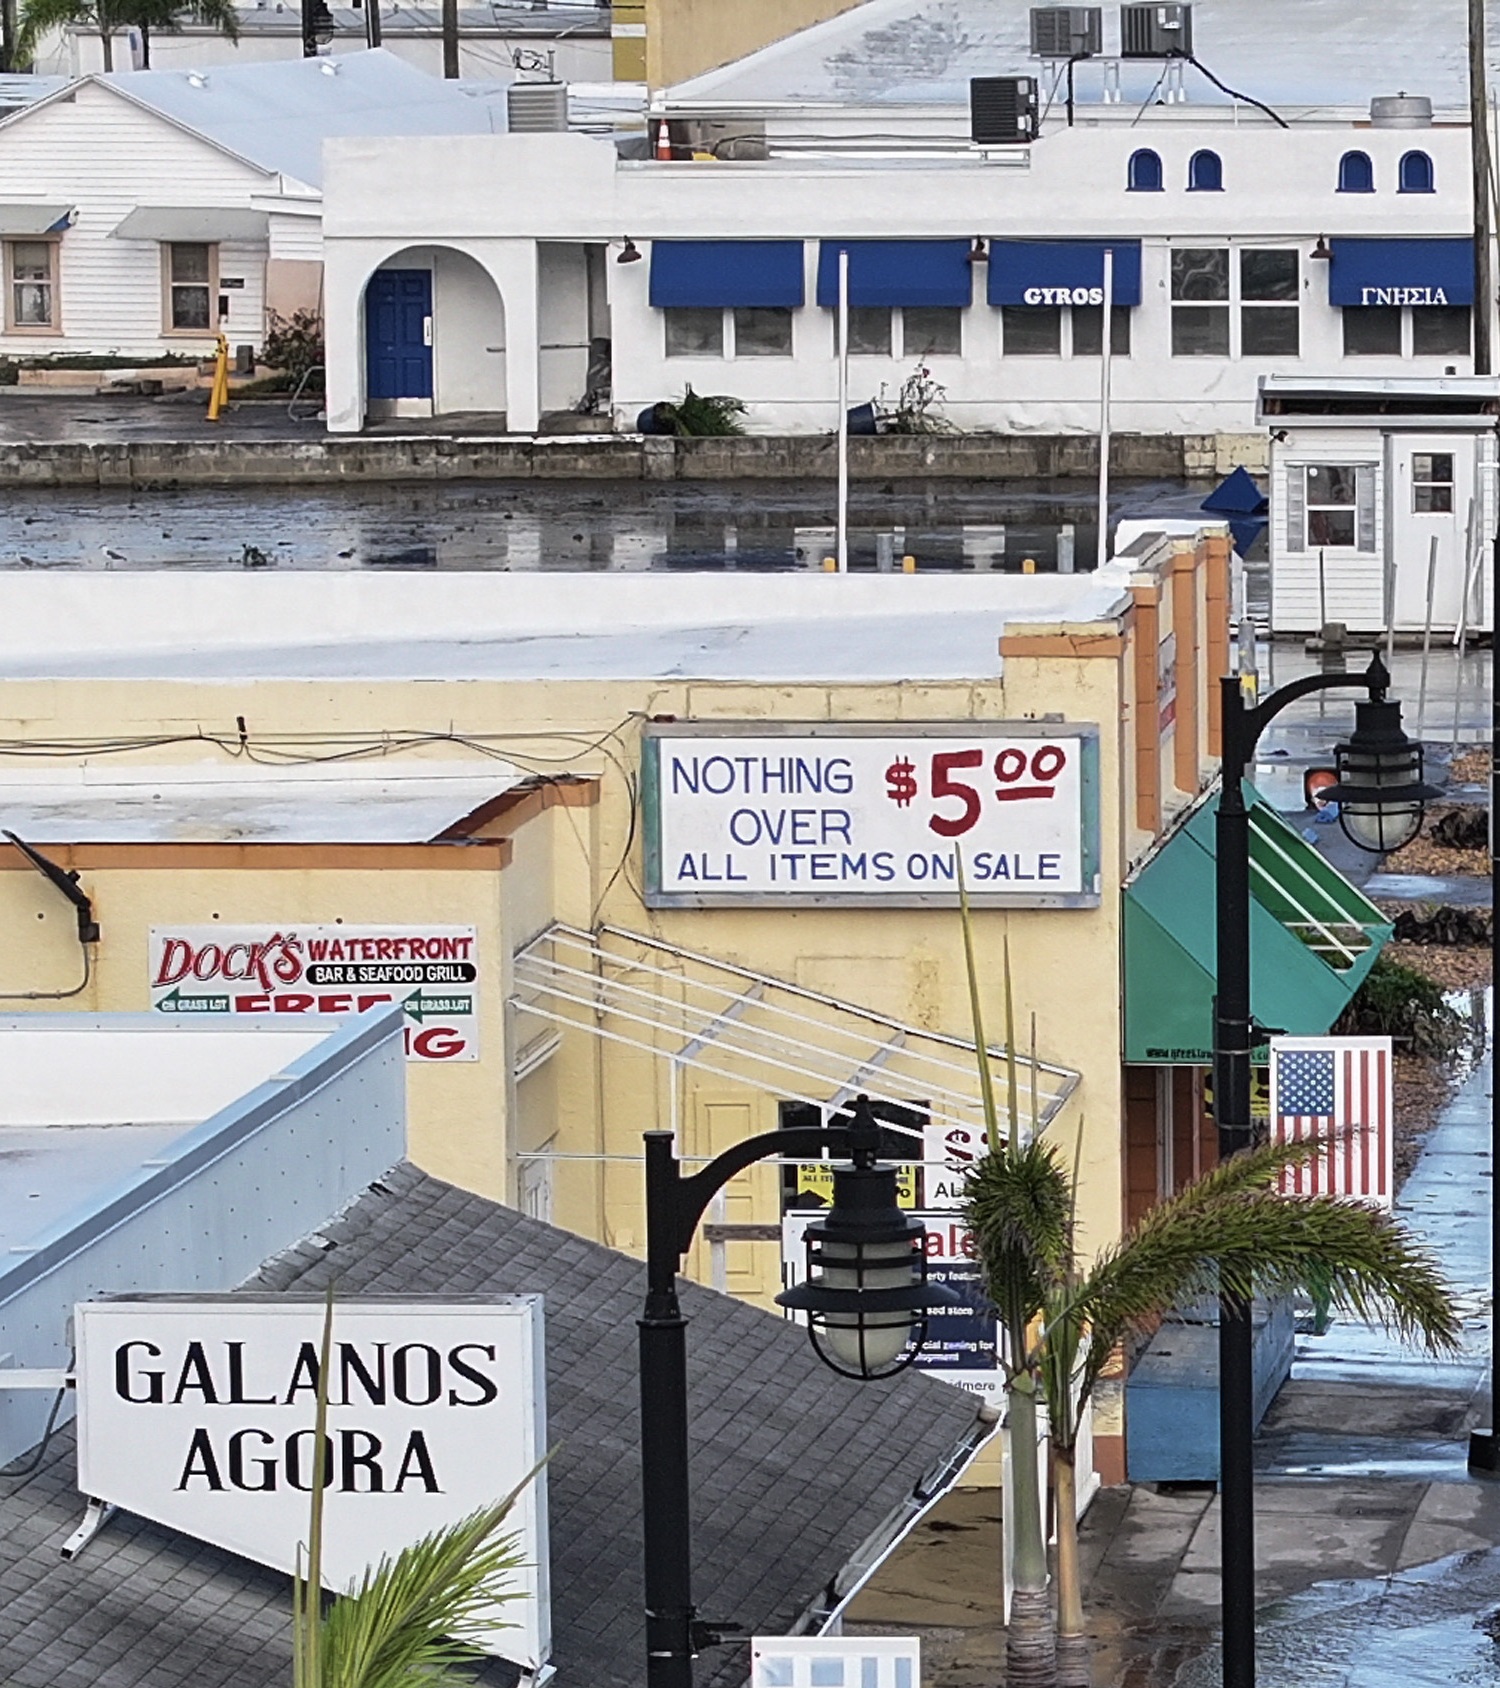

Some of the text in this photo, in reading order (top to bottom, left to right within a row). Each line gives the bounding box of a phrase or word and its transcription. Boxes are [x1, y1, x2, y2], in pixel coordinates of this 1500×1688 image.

[1024, 287, 1104, 305] GYROS
[1361, 286, 1448, 305] ΓΝΗΣΙΑ
[672, 756, 854, 795] NOTHING
[730, 808, 852, 846] OVER
[677, 853, 1061, 881] ALL ITEMS ON SALE
[307, 937, 474, 962] WATERFRONT
[315, 962, 467, 983] BAR & SEAFOOD GRILL
[178, 1000, 207, 1010] GRASS
[209, 1000, 228, 1010] LOT
[115, 1340, 499, 1407] GALANOS
[173, 1427, 447, 1493] AGORA
